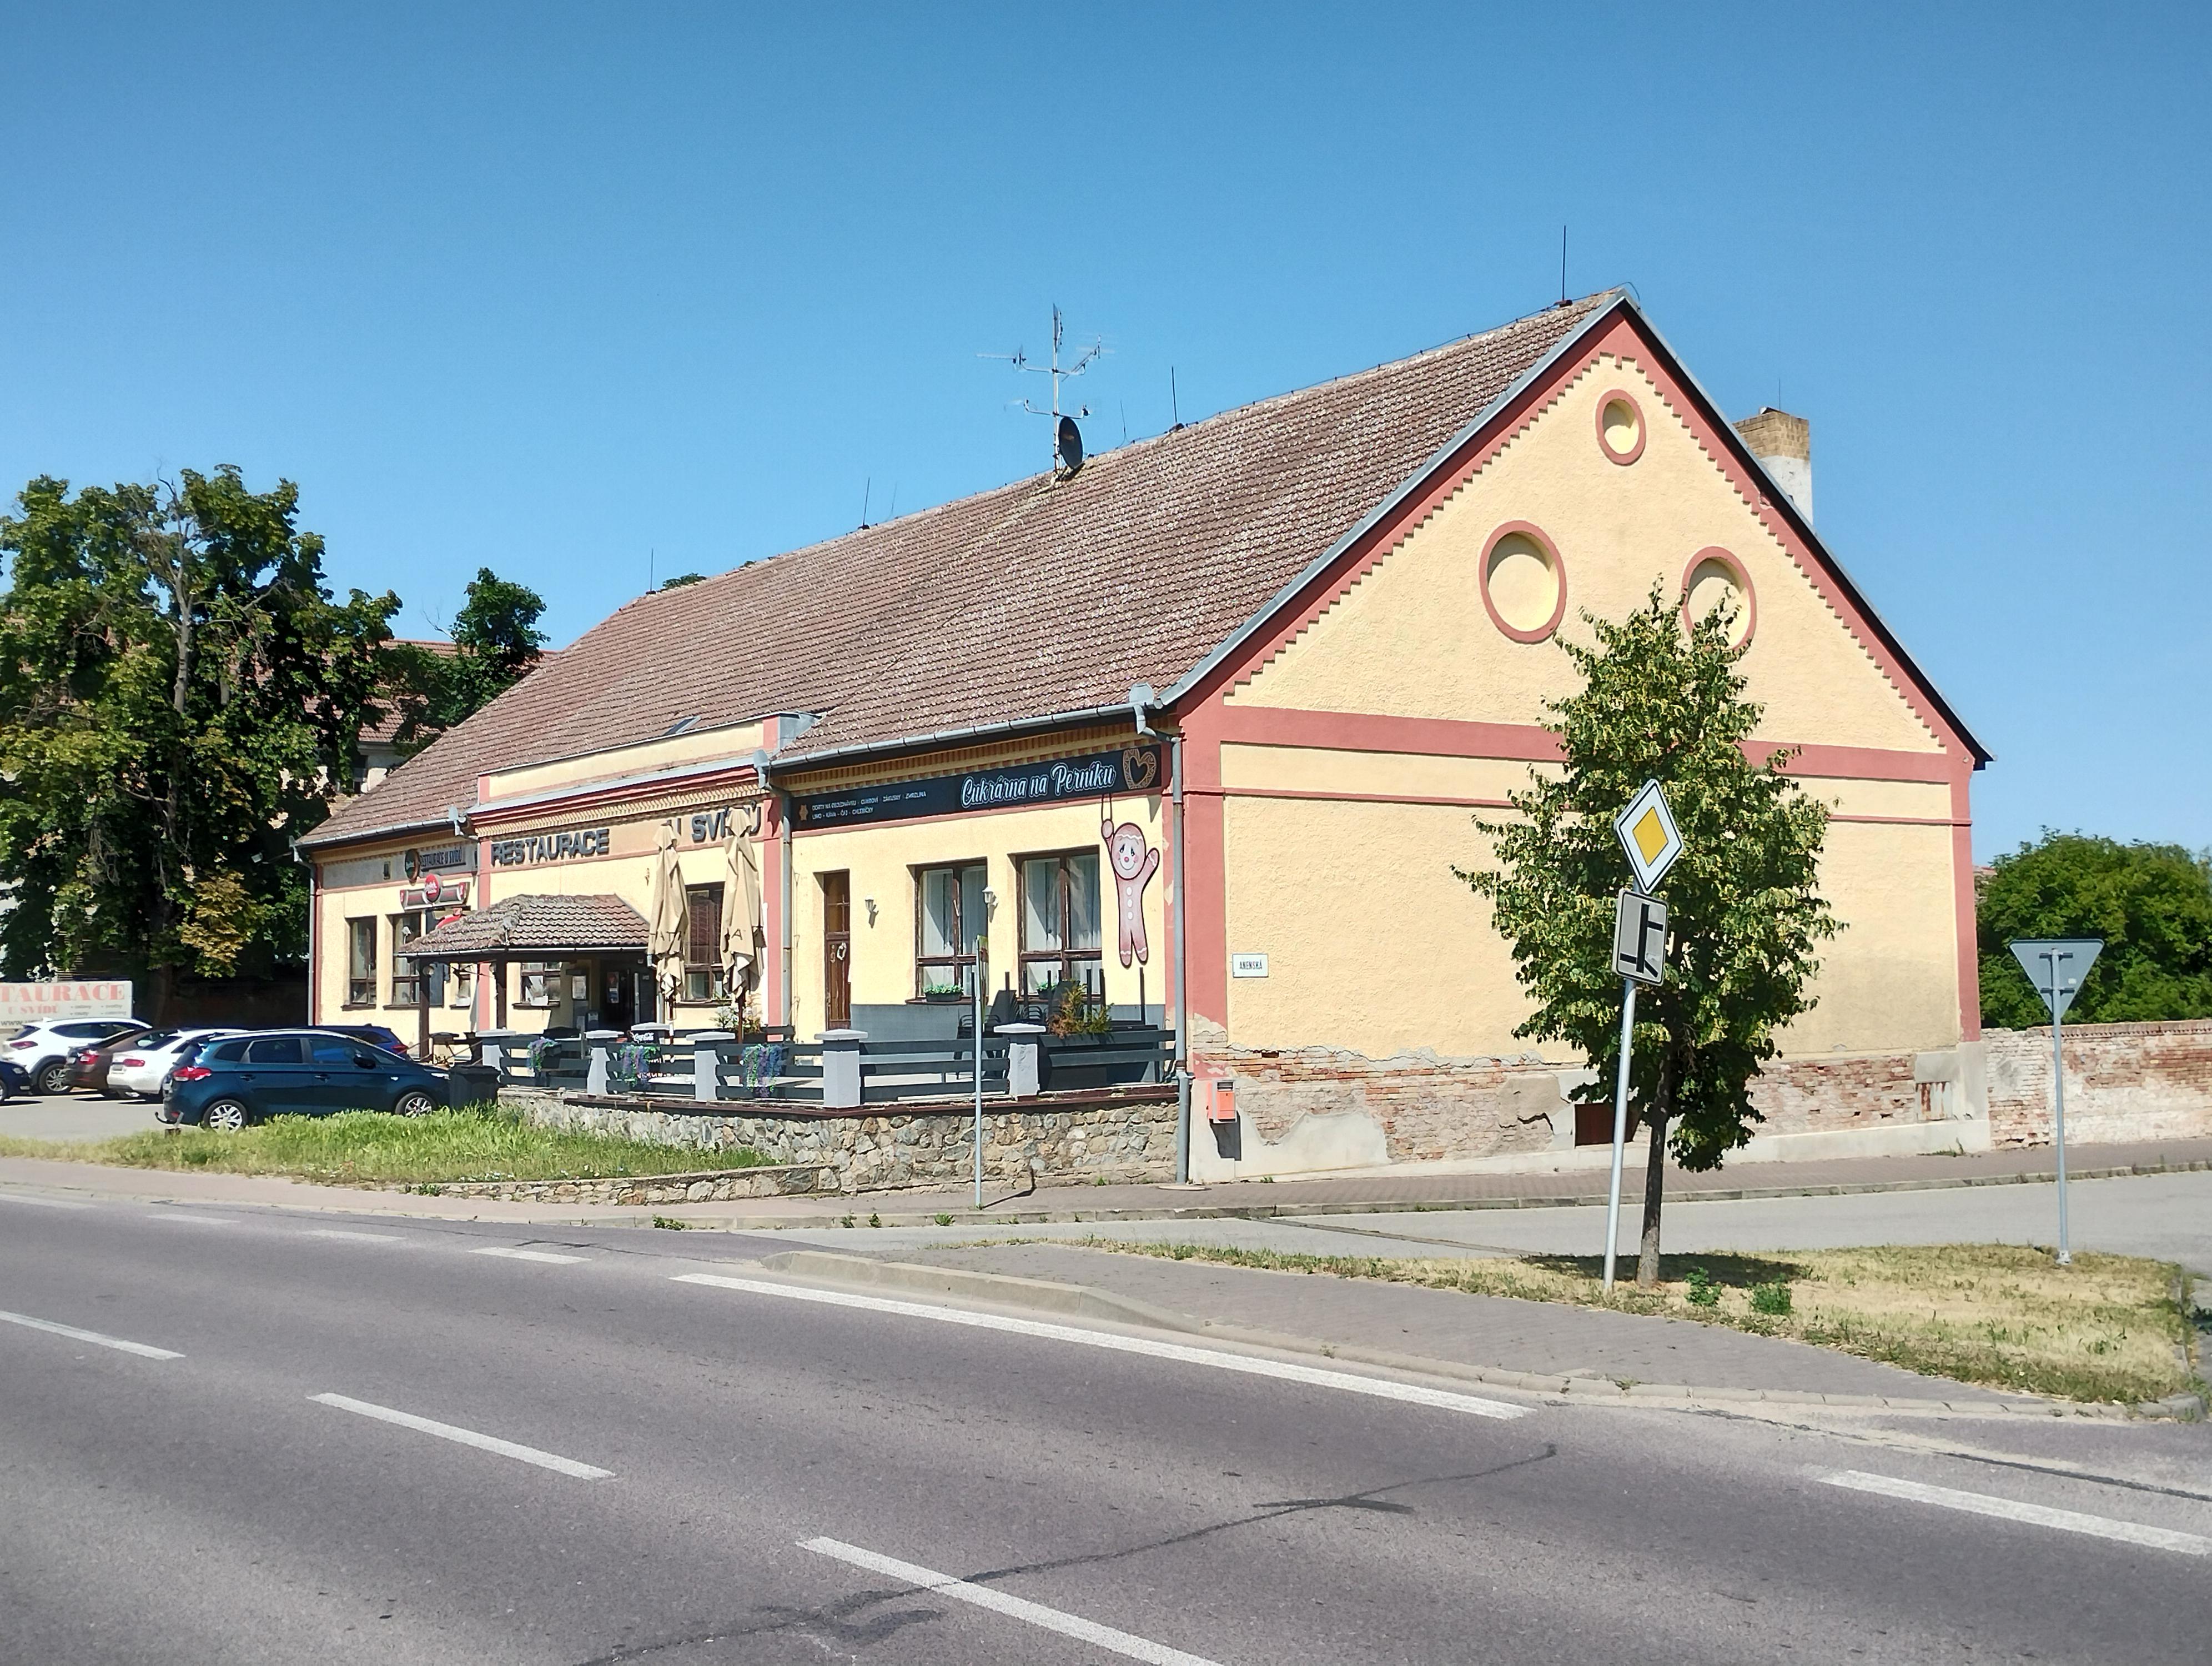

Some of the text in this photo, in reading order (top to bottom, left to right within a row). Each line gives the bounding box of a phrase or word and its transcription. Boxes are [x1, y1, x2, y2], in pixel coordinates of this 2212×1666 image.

[961, 761, 1116, 807] Cukrárna na Perníku
[491, 829, 610, 867] RESTAURACE
[1239, 959, 1263, 970] ANENSKÁ
